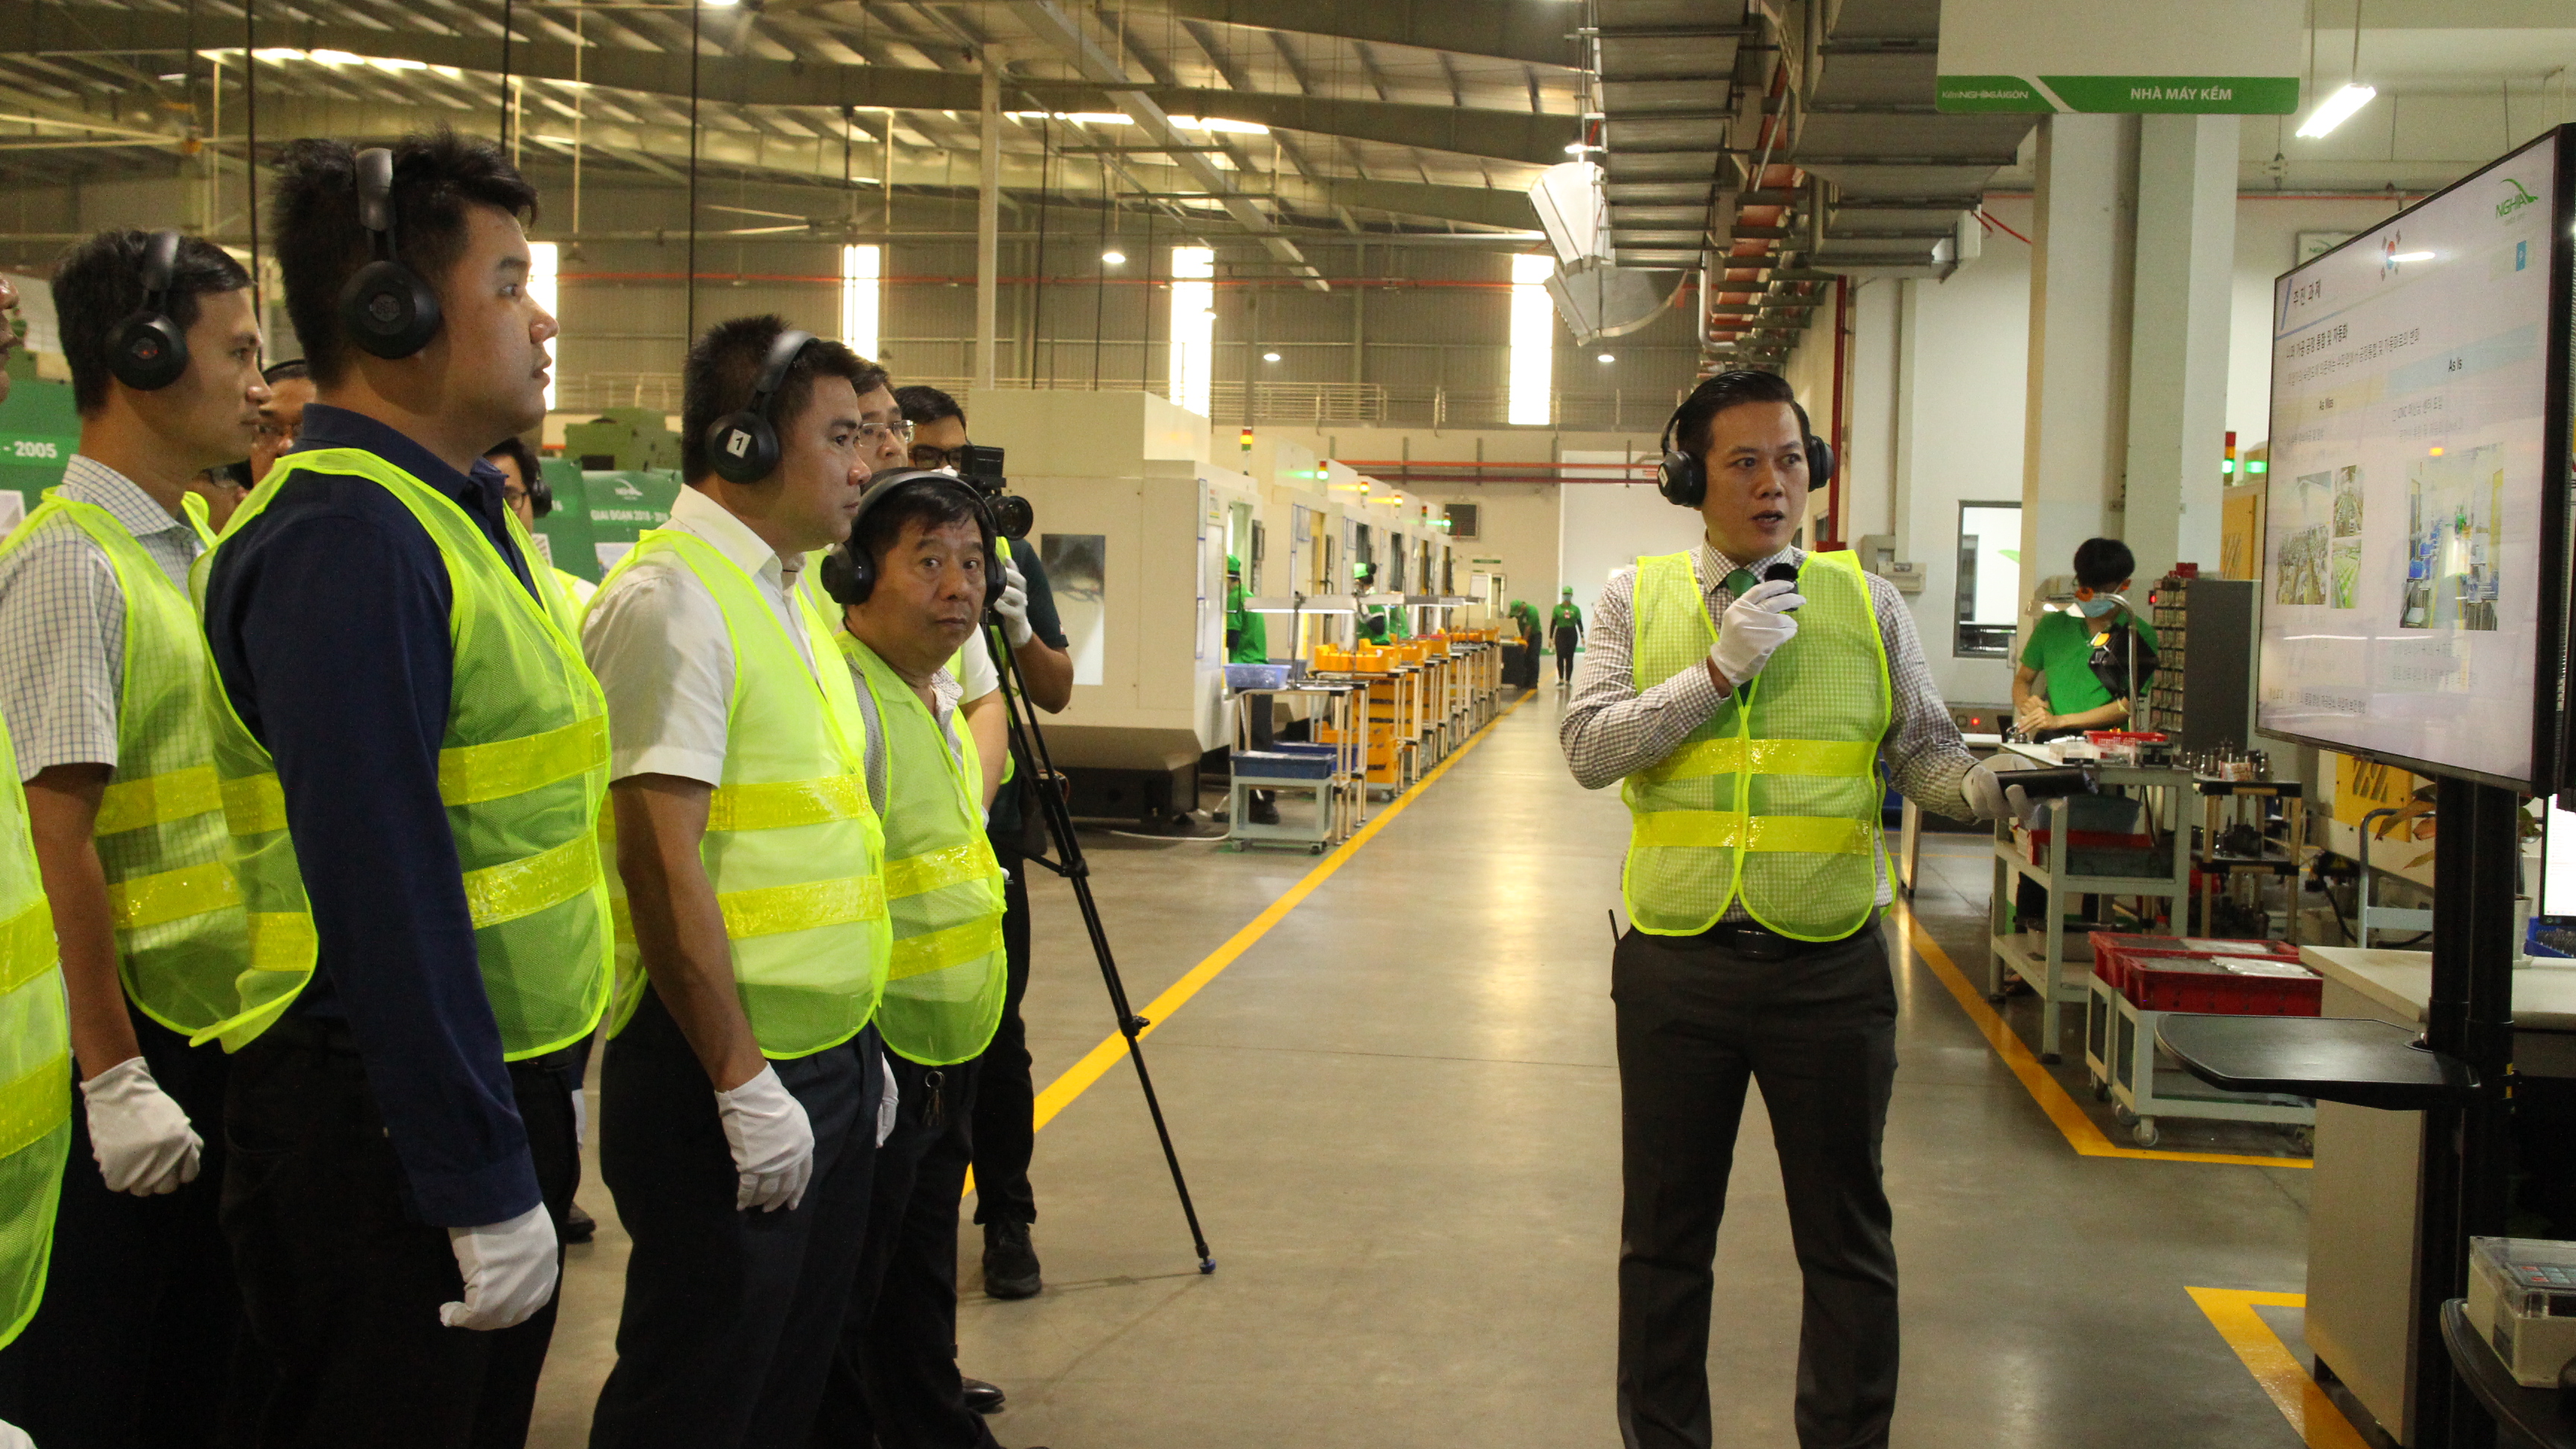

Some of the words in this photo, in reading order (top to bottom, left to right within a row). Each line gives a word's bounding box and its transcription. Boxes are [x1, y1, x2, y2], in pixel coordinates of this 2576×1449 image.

[2131, 86, 2162, 99] NHÀ
[2166, 86, 2197, 99] MÁY
[14, 441, 57, 458] 2005
[736, 437, 744, 451] 1
